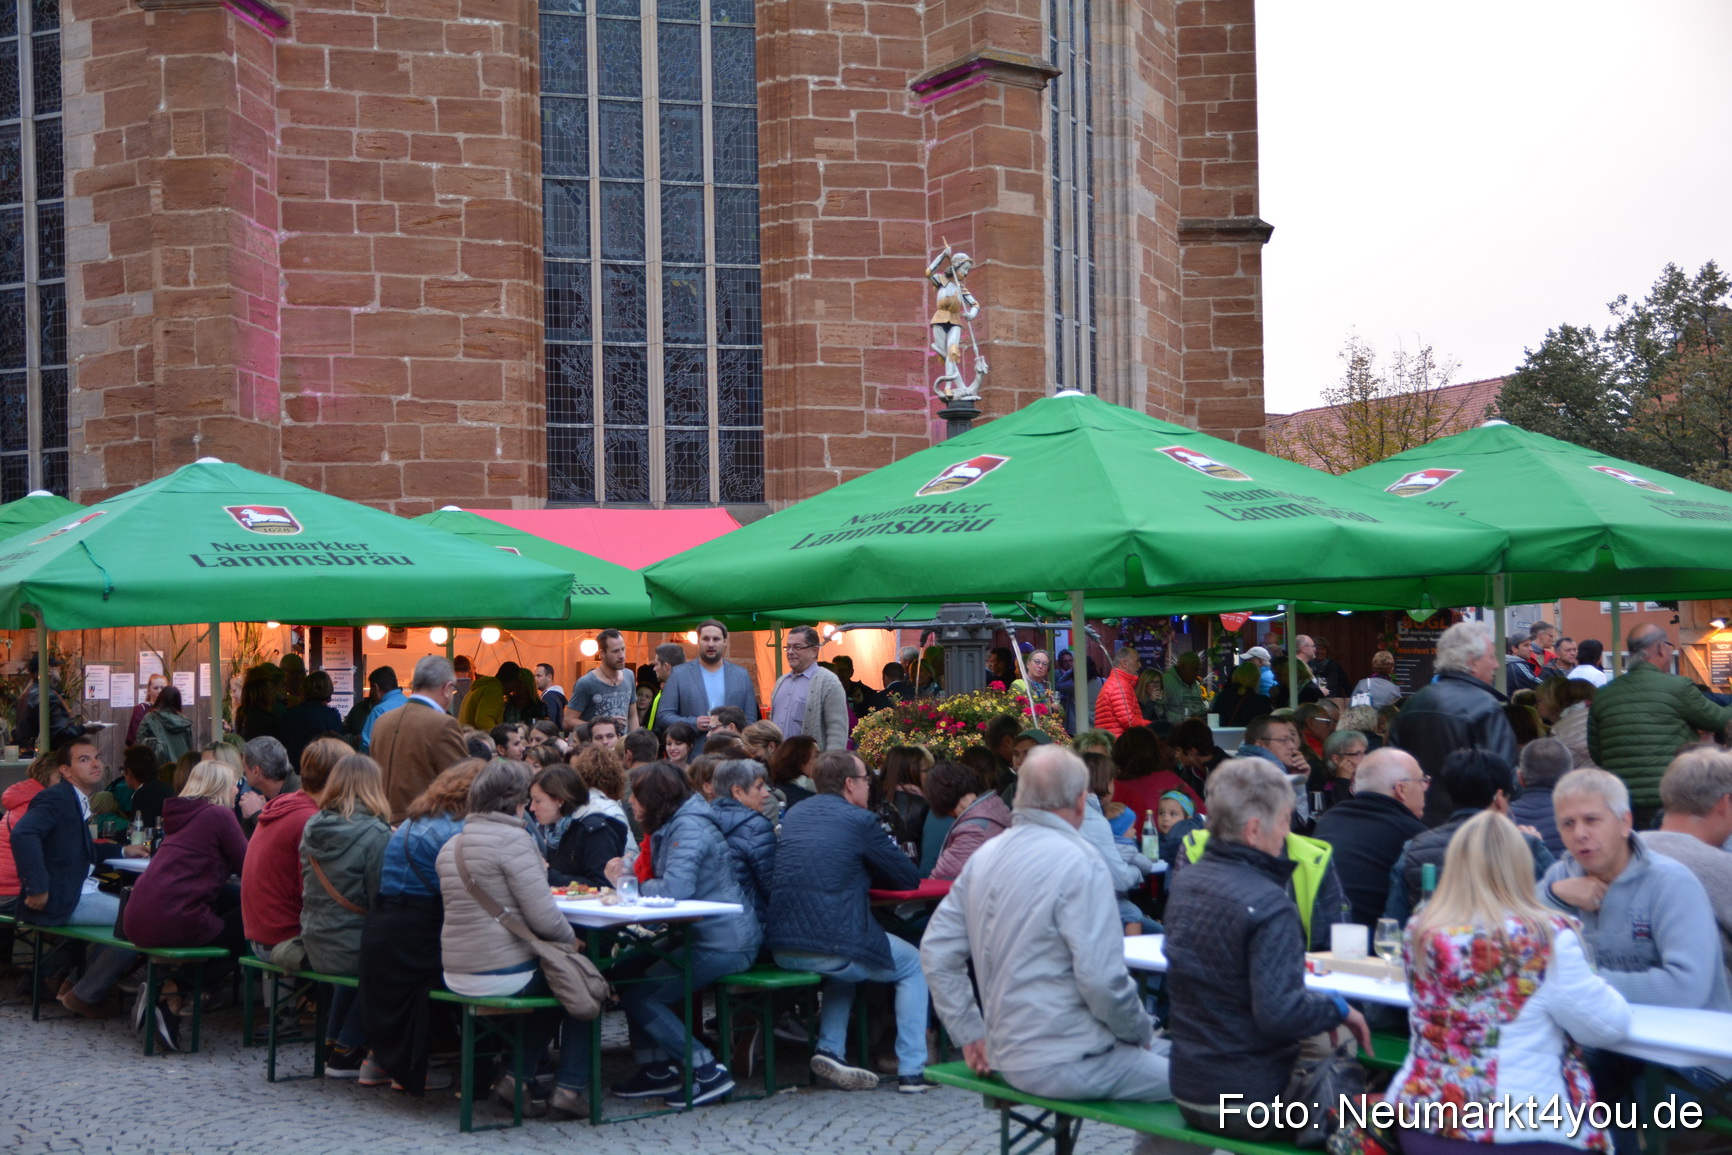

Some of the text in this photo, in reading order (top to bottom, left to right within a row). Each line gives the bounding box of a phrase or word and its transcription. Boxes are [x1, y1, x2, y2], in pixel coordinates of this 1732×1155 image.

[840, 501, 993, 527] Neumarkter
[788, 515, 997, 550] Lammsbräu
[209, 541, 370, 553] Neumarkter
[188, 552, 416, 568] Lammsbräu
